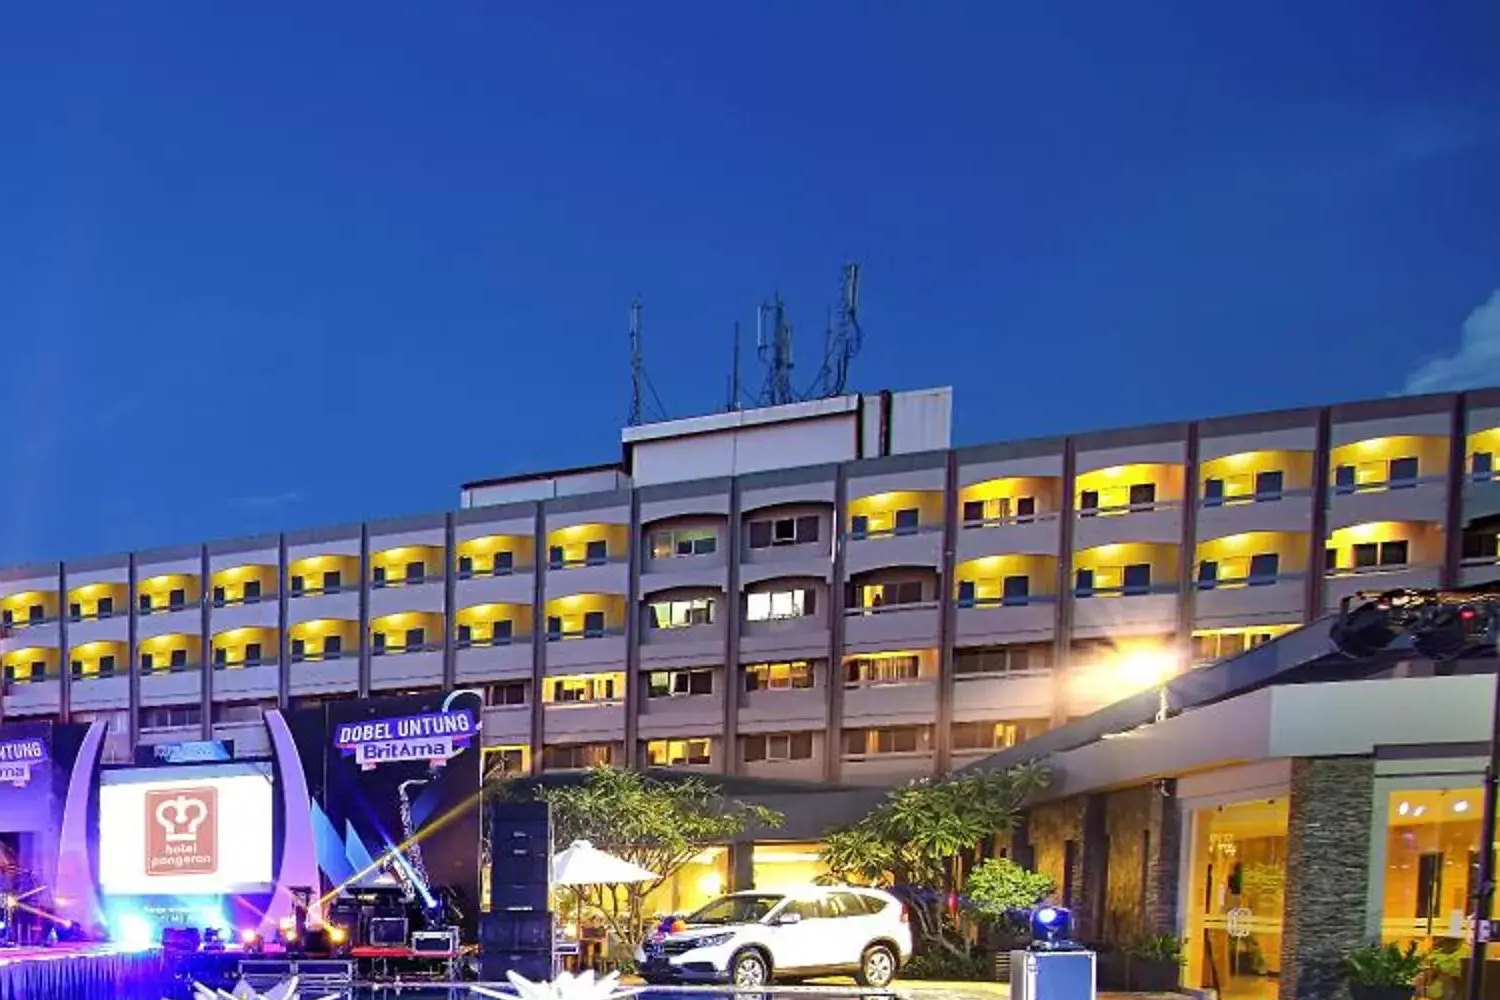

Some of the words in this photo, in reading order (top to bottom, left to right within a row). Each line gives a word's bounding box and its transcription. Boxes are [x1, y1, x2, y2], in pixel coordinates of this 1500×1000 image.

[339, 723, 393, 743] DOBEL
[398, 713, 469, 737] UNTUNG
[363, 742, 445, 760] BritAma
[165, 842, 197, 855] hotel
